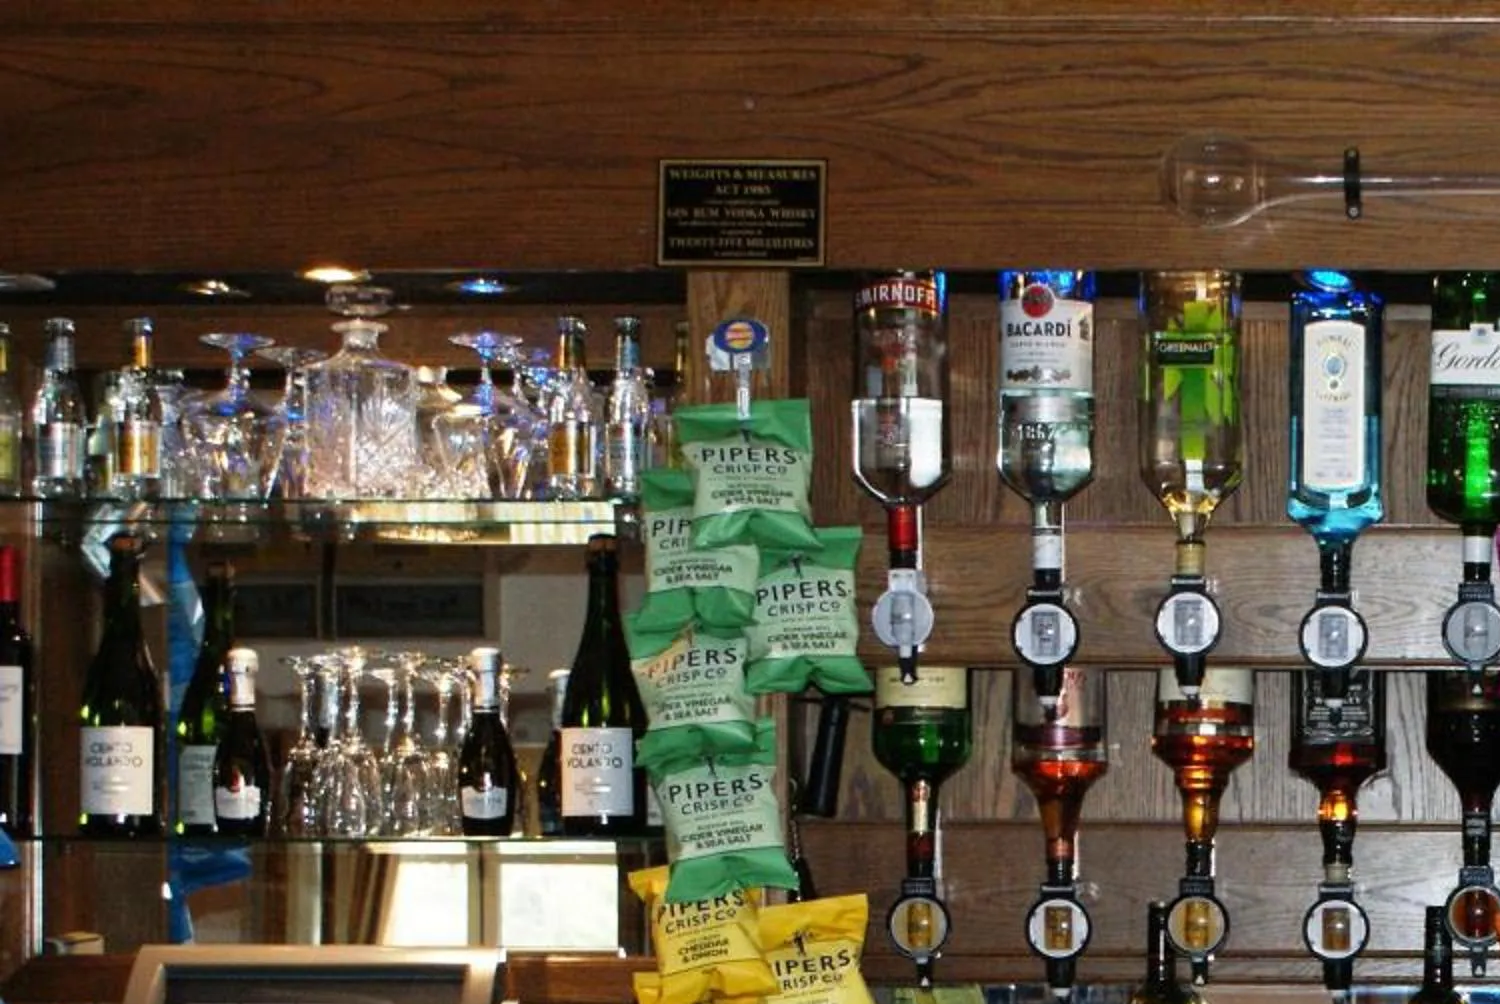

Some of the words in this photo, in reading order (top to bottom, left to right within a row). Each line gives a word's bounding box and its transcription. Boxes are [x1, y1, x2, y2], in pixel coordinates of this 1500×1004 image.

[715, 184, 738, 195] ACT
[702, 447, 797, 464] PIPERS
[713, 464, 762, 475] CRISP
[653, 519, 692, 537] PIP
[659, 539, 688, 548] CRI
[756, 580, 849, 605] PIPERS
[768, 604, 815, 616] CRISP
[648, 647, 737, 678] PIPERS
[656, 670, 701, 688] CRISP
[669, 773, 763, 802] PIPERS
[681, 801, 729, 815] CRISP
[666, 912, 710, 933] CRISP
[775, 949, 851, 976] IPERS
[783, 974, 818, 990] RISP
